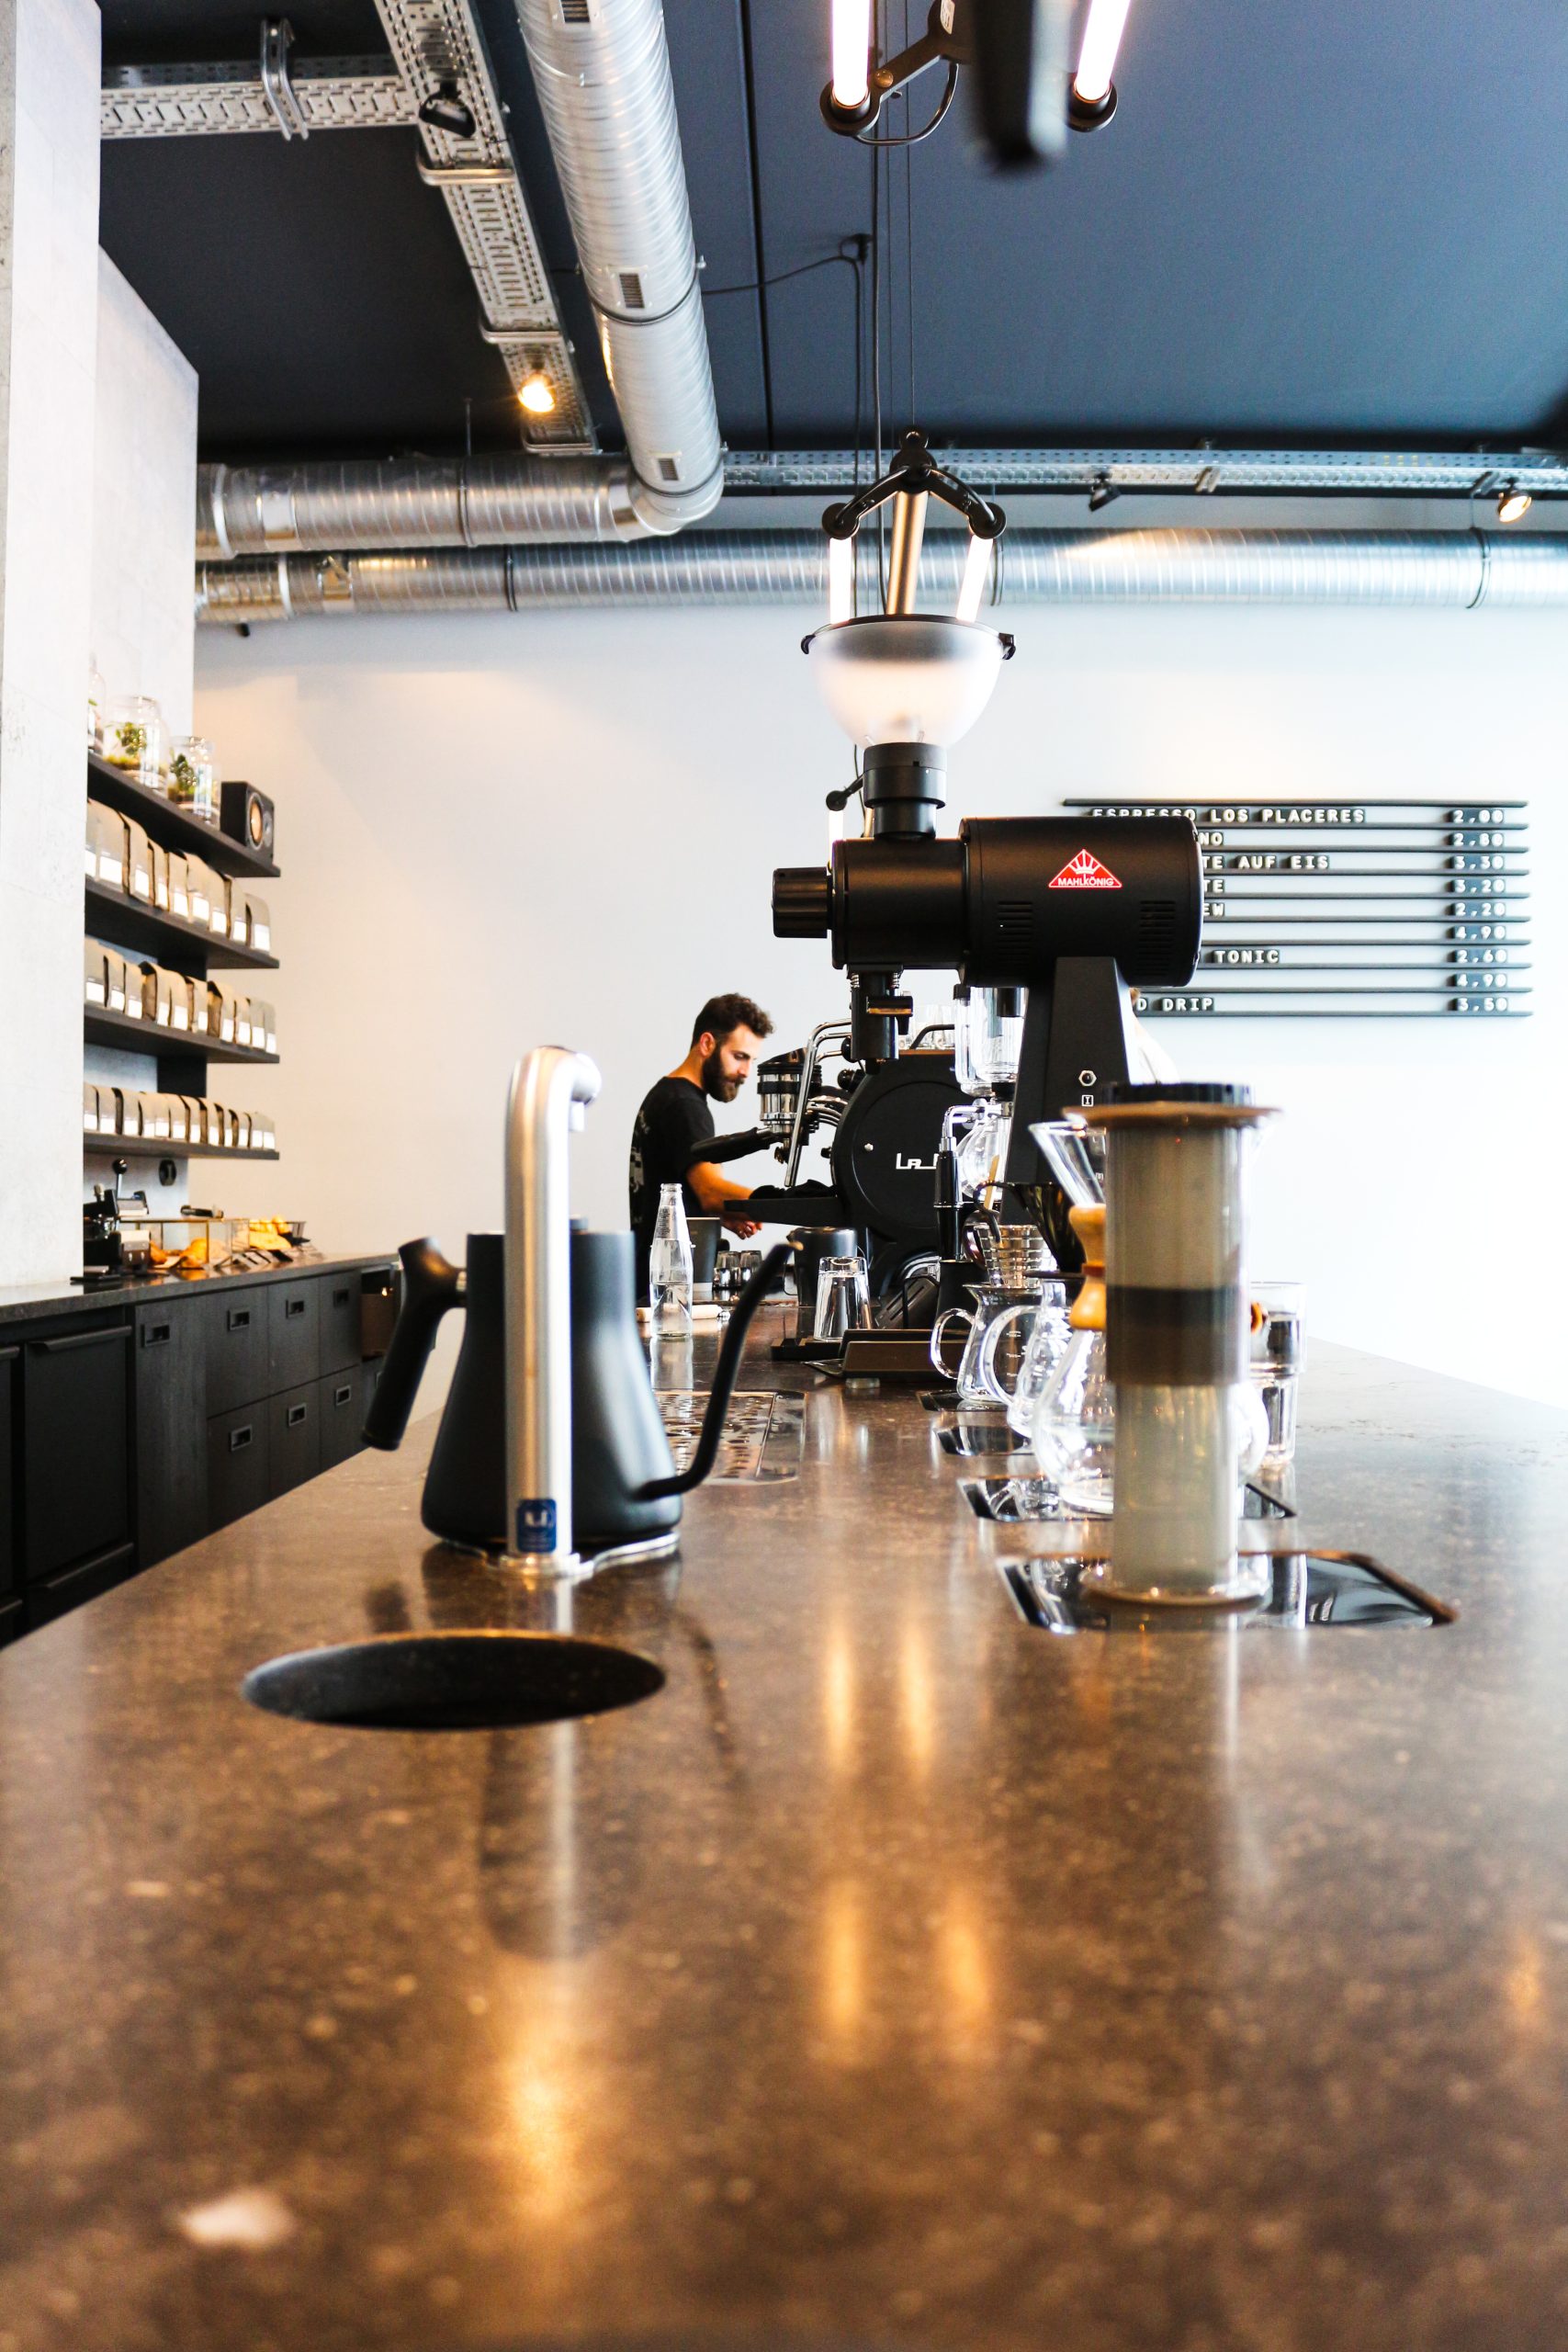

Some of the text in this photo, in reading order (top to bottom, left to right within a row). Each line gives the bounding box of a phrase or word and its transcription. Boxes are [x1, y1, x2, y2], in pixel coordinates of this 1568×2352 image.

[1211, 808, 1248, 823] LOS
[1262, 808, 1364, 823] PLACERES
[1453, 809, 1503, 823] 2,00
[1238, 855, 1275, 869] AUF
[1291, 855, 1327, 869] EIS
[1454, 855, 1504, 869] 3,30
[1057, 876, 1114, 886] MAHLKÖNIG
[1455, 879, 1505, 893] 3,20
[1456, 902, 1506, 916] 2,20
[1456, 926, 1506, 940] 4,90
[1214, 949, 1506, 963] TONIC 2,60
[1457, 973, 1506, 987] 4,90
[1163, 998, 1213, 1011] DRIP
[1458, 998, 1507, 1012] 3,50
